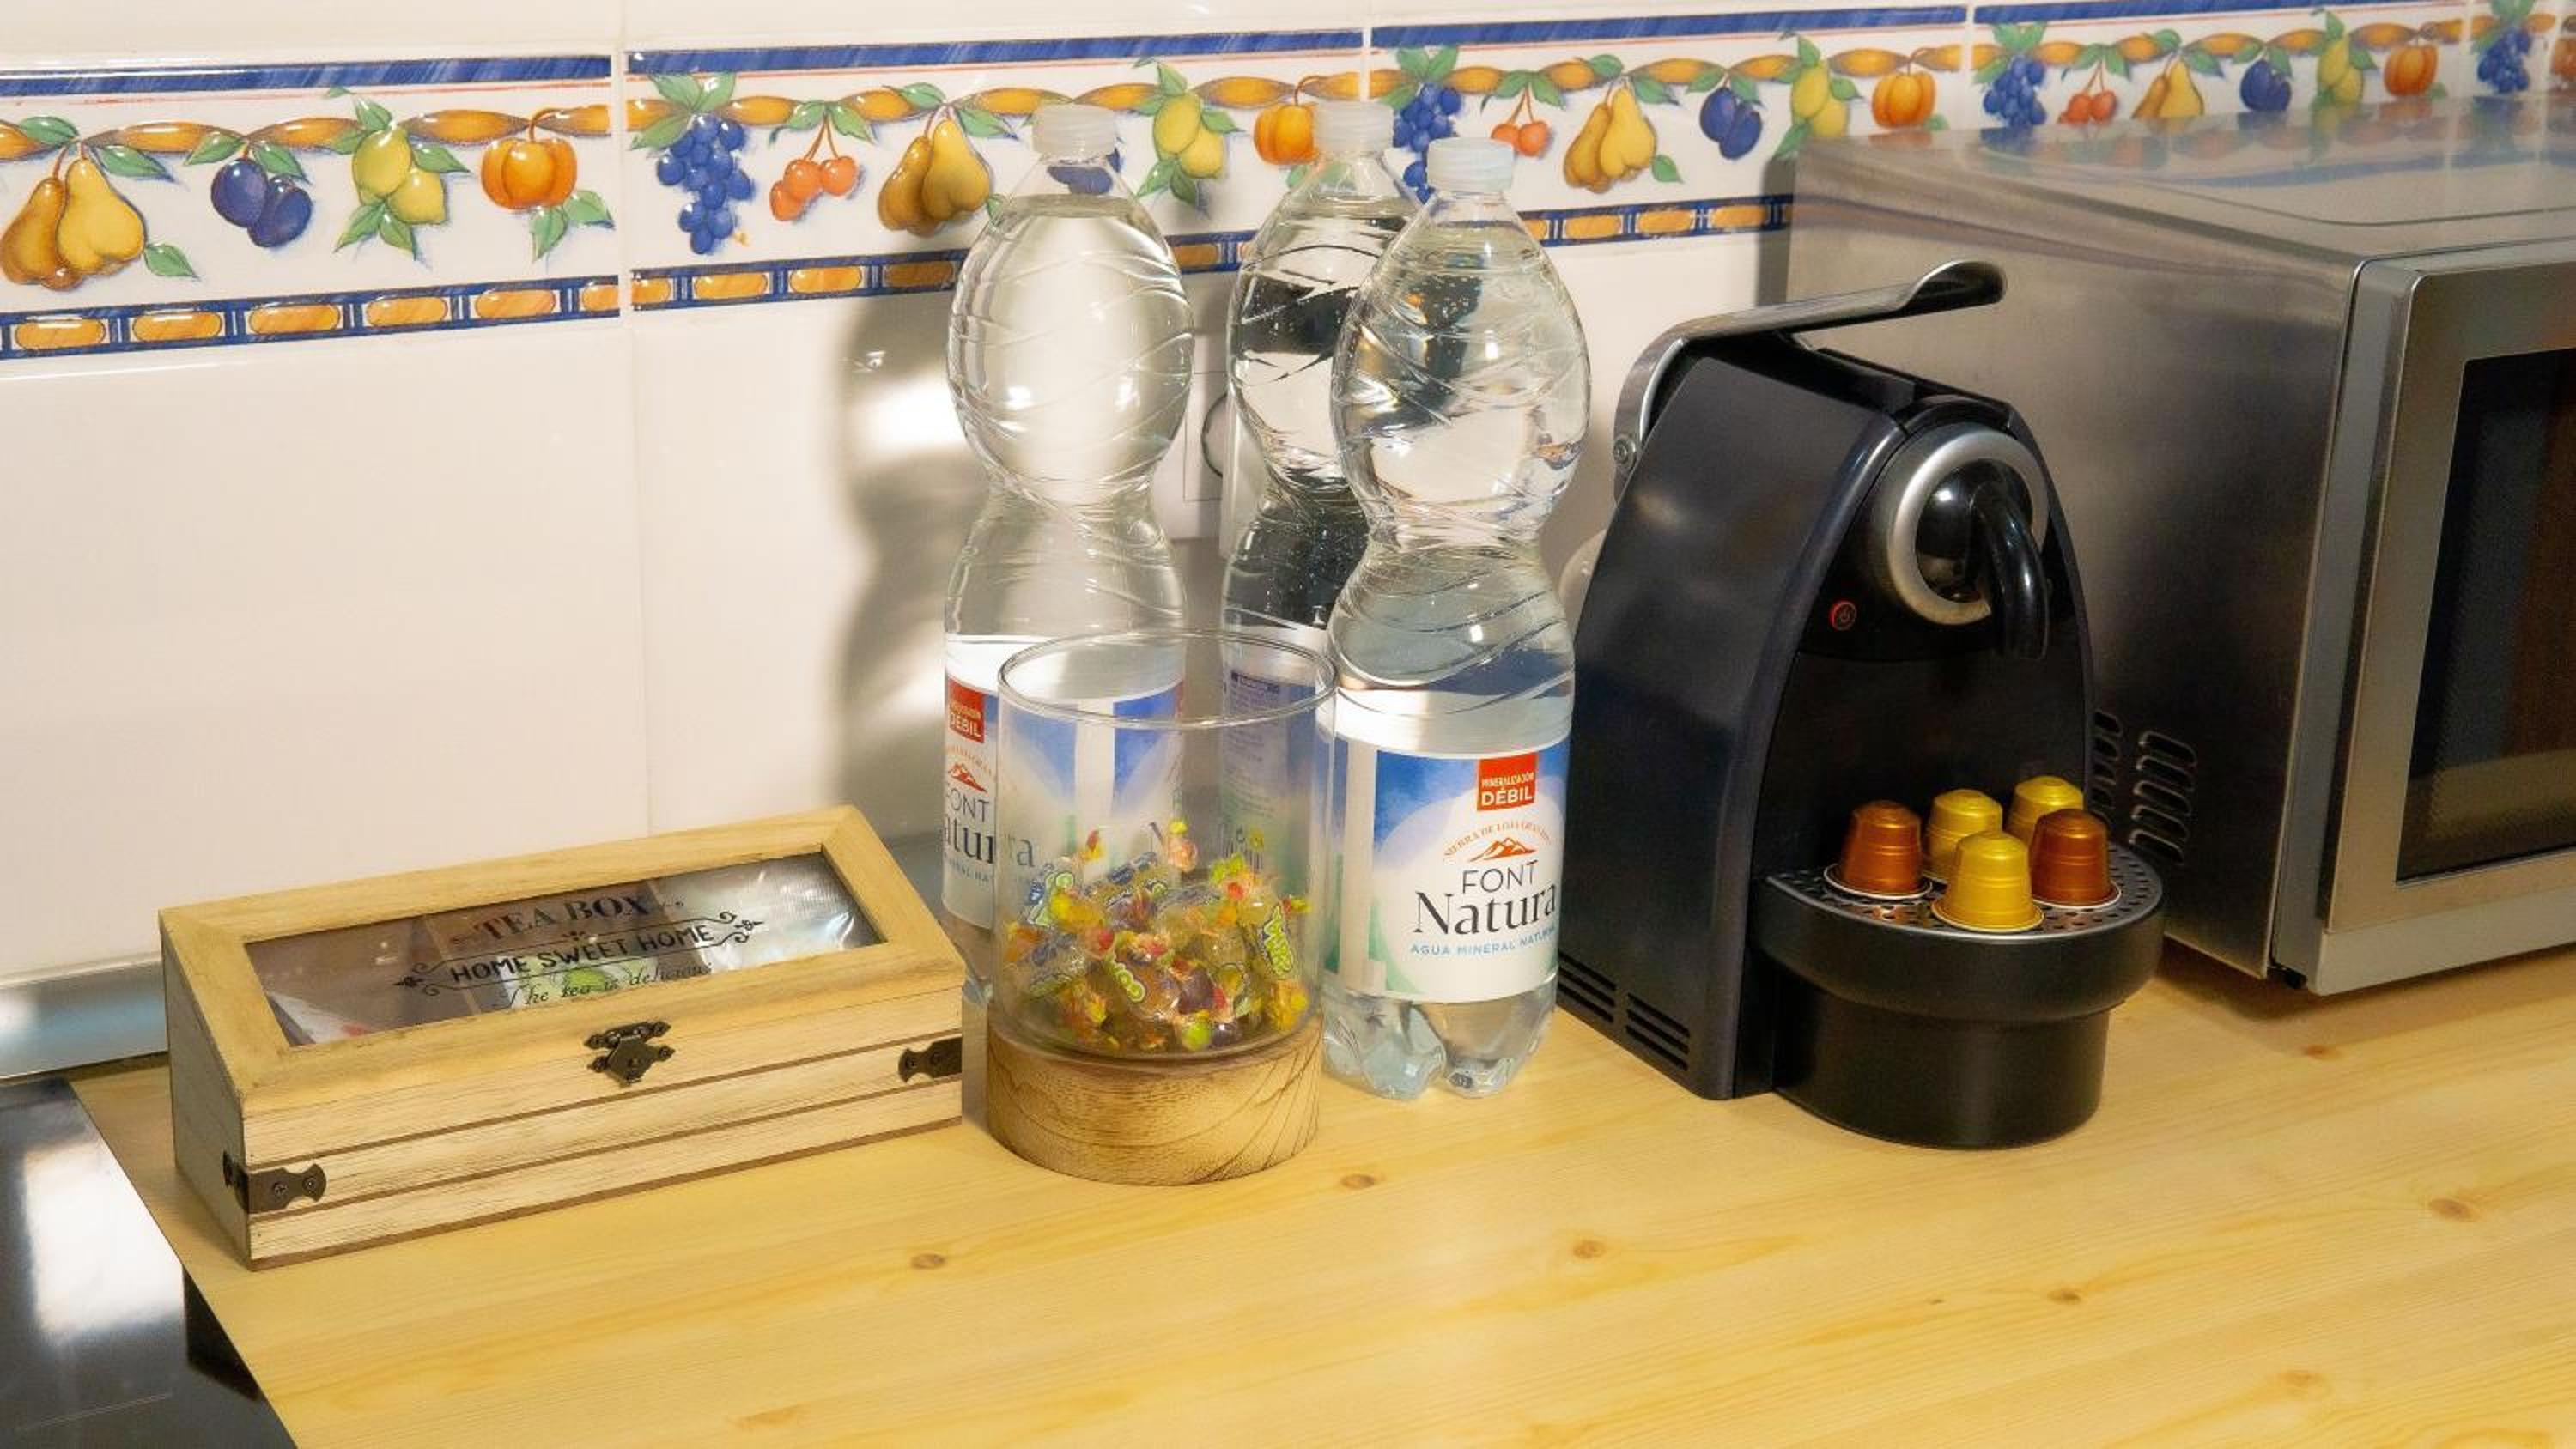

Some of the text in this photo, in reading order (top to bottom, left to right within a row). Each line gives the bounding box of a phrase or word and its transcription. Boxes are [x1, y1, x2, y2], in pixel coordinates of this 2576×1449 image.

[1481, 785, 1533, 806] DÉBIL
[1462, 859, 1538, 894] FONT
[474, 895, 651, 940] TEA BOX
[1413, 882, 1557, 935] Natura
[450, 925, 714, 983] HOME SWEET HOME
[1410, 943, 1450, 955] AGUA
[1456, 941, 1516, 955] MINERAL
[560, 982, 592, 998] tea
